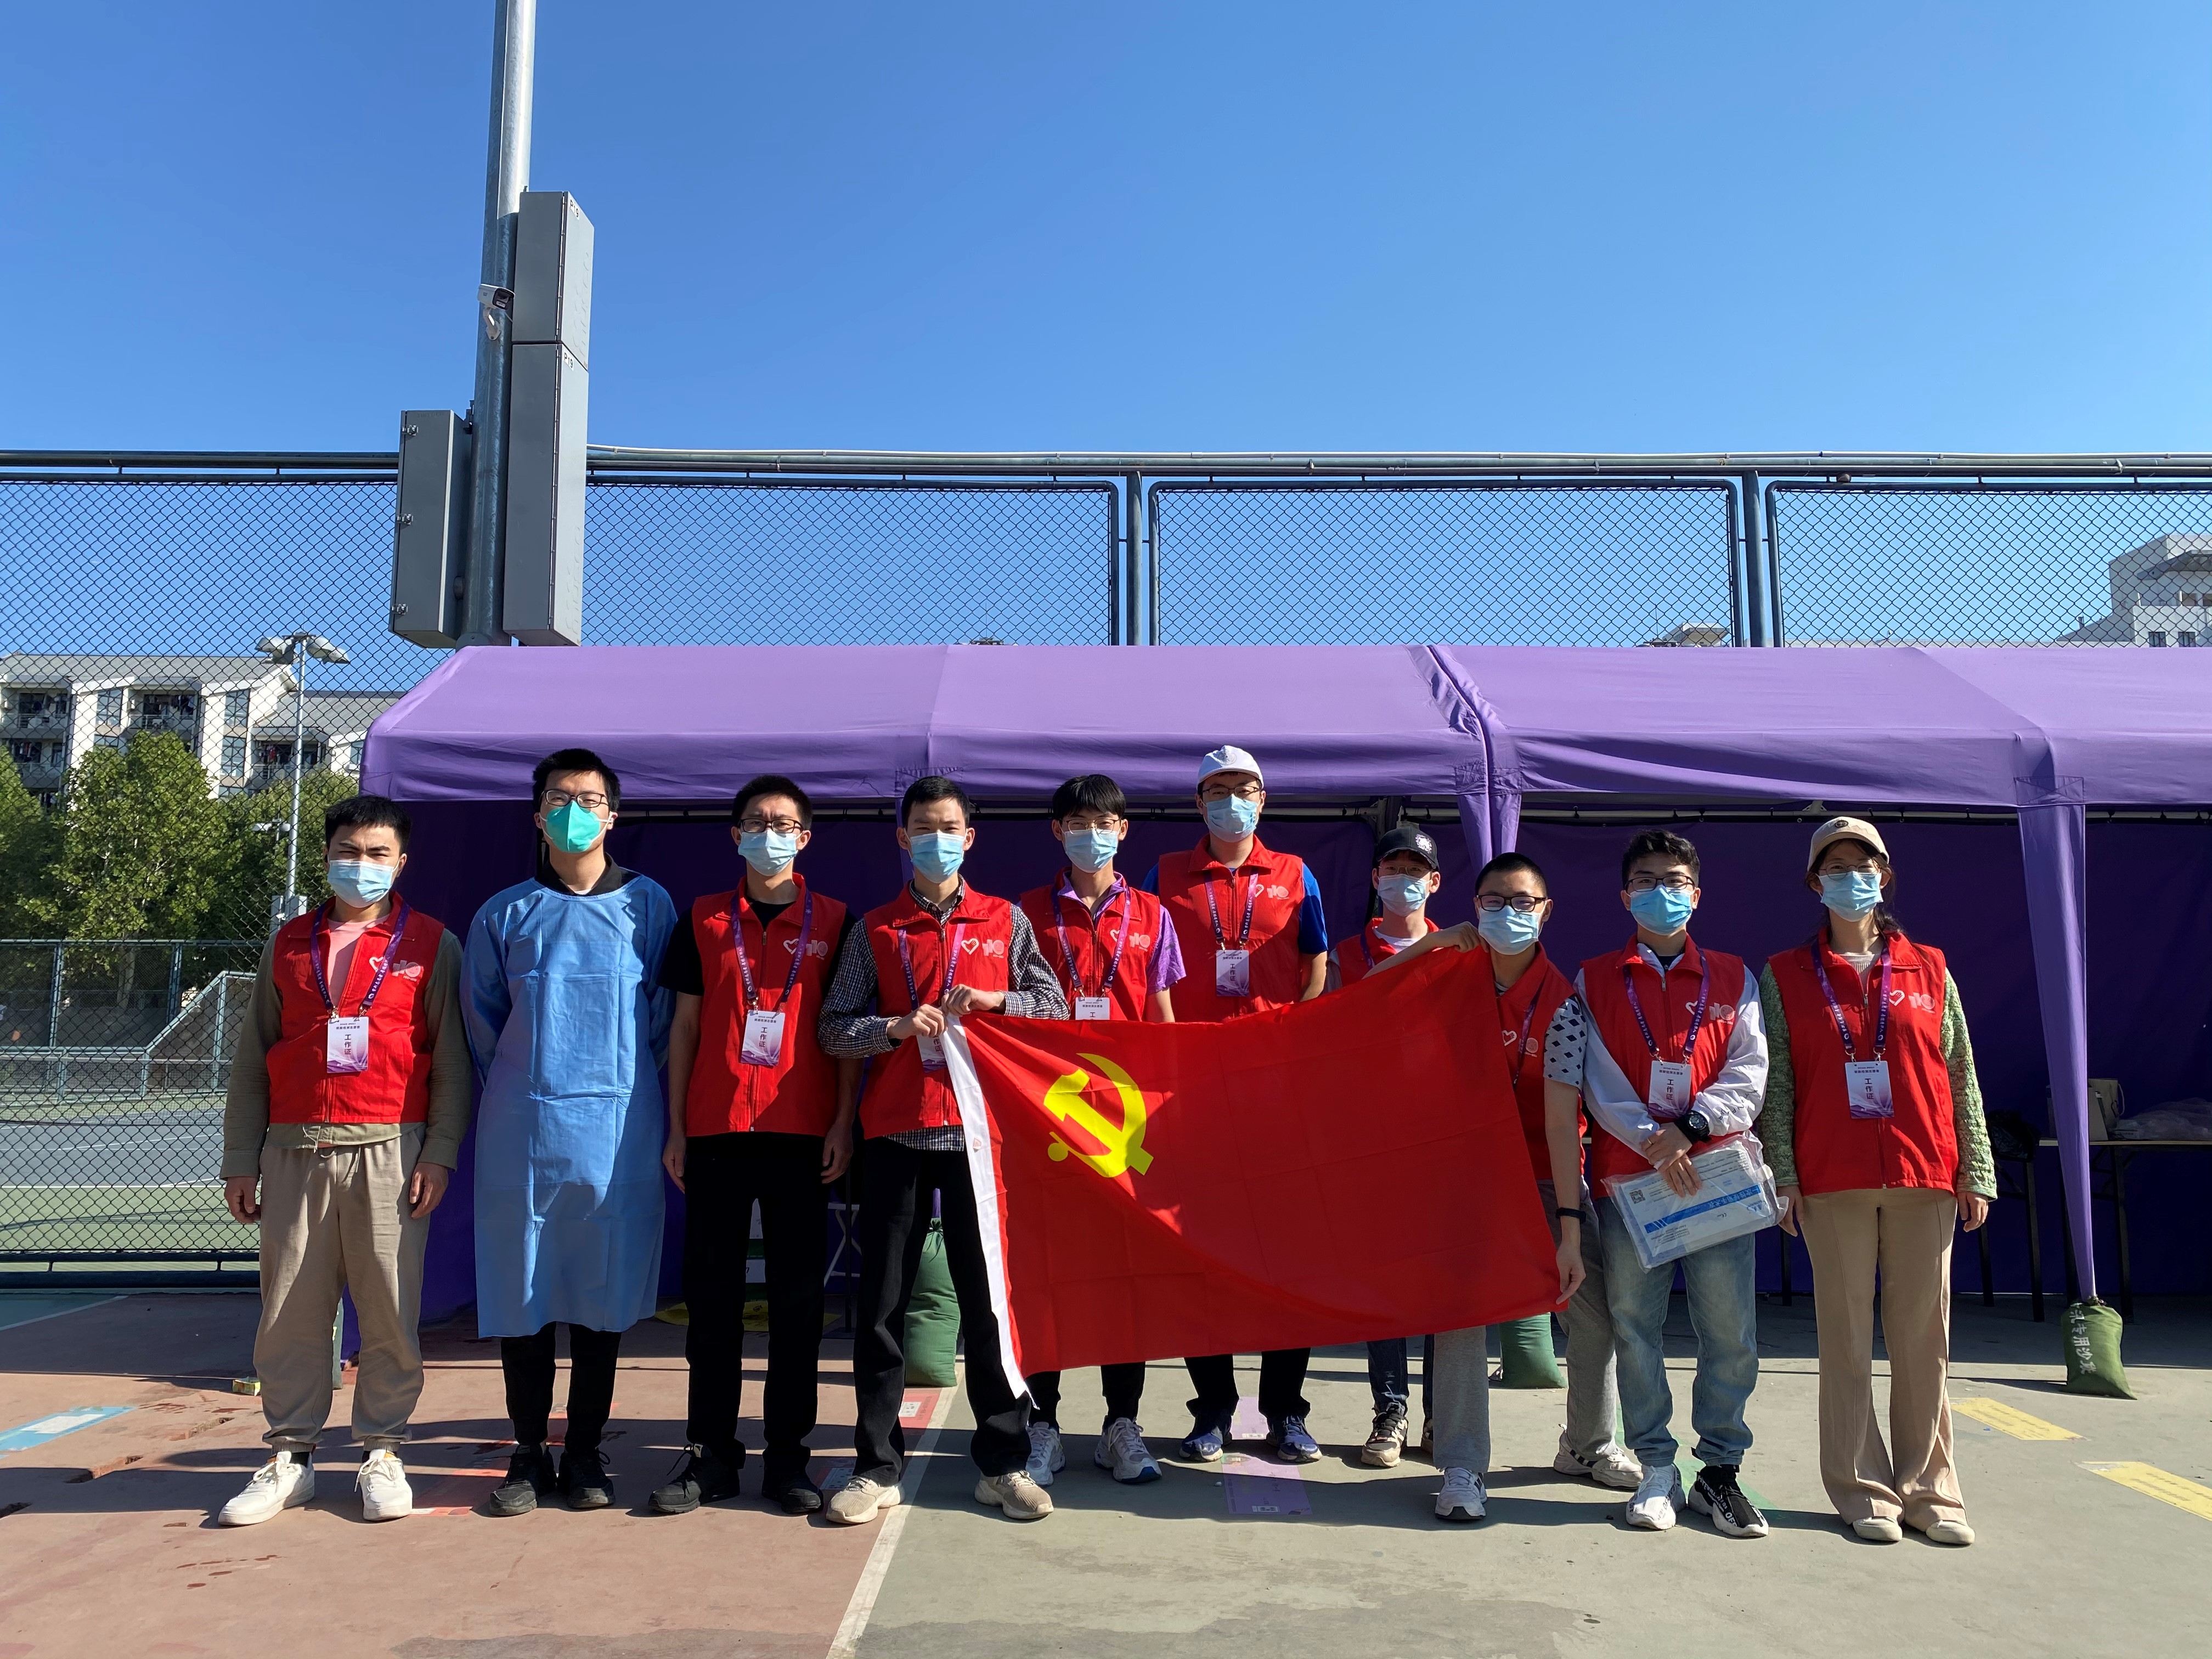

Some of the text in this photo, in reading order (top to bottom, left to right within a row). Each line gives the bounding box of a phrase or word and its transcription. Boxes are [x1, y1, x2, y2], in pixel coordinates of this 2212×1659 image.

[570, 199, 579, 217] P19
[564, 352, 573, 368] P19
[759, 1027, 768, 1047] 工作证
[933, 1035, 942, 1052] 作证
[1666, 1079, 1674, 1101] 工作证
[1865, 1078, 1874, 1100] 工作证
[1707, 1188, 1757, 1209] 一次性使用手术衣
[2069, 1302, 2097, 1375] 汛专用沙袋
